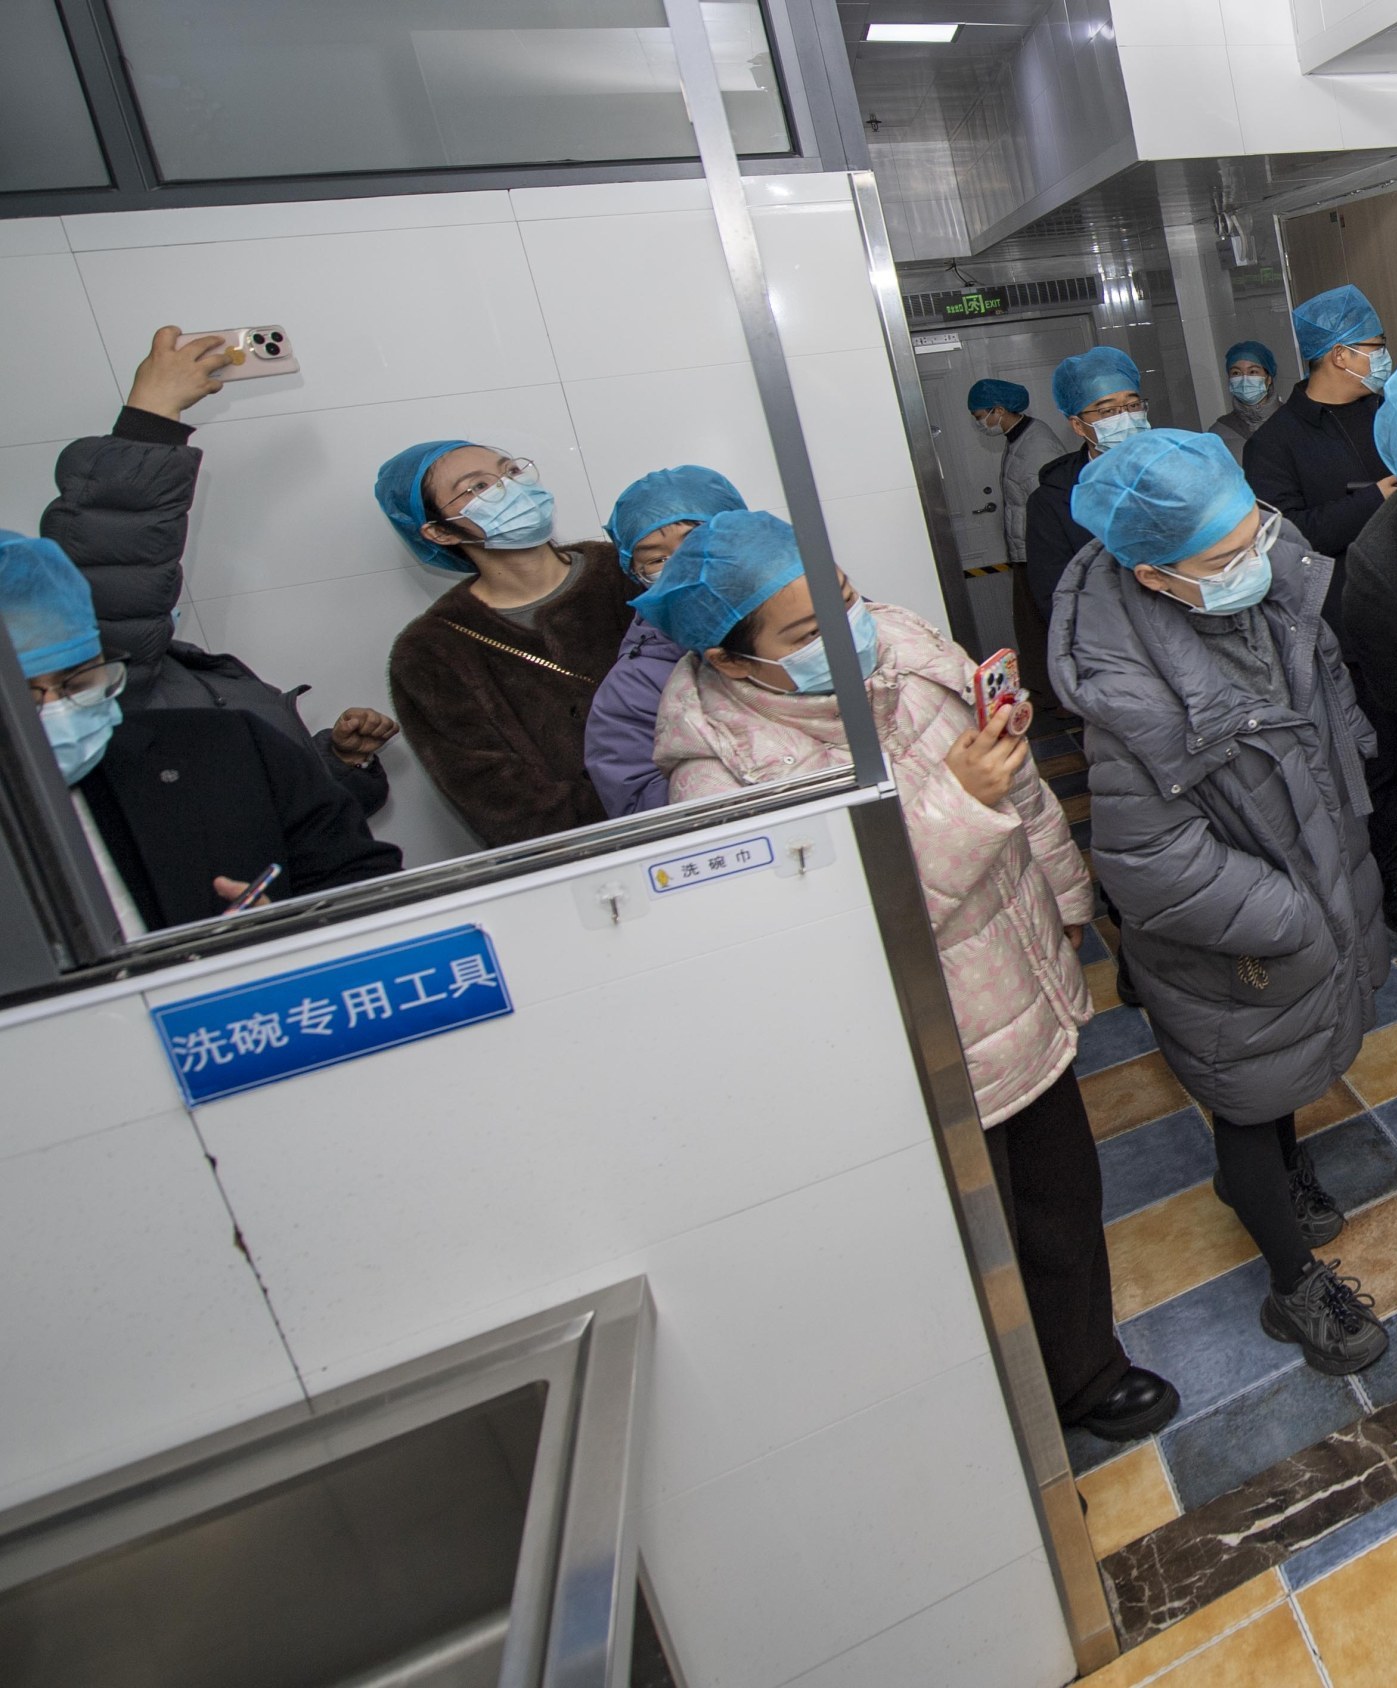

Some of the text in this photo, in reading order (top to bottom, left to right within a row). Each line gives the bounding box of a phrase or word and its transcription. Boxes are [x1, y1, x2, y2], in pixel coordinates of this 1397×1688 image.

[984, 299, 1001, 309] EXIT
[681, 848, 751, 878] 洗碗巾
[171, 953, 498, 1073] 洗碗专用工具
